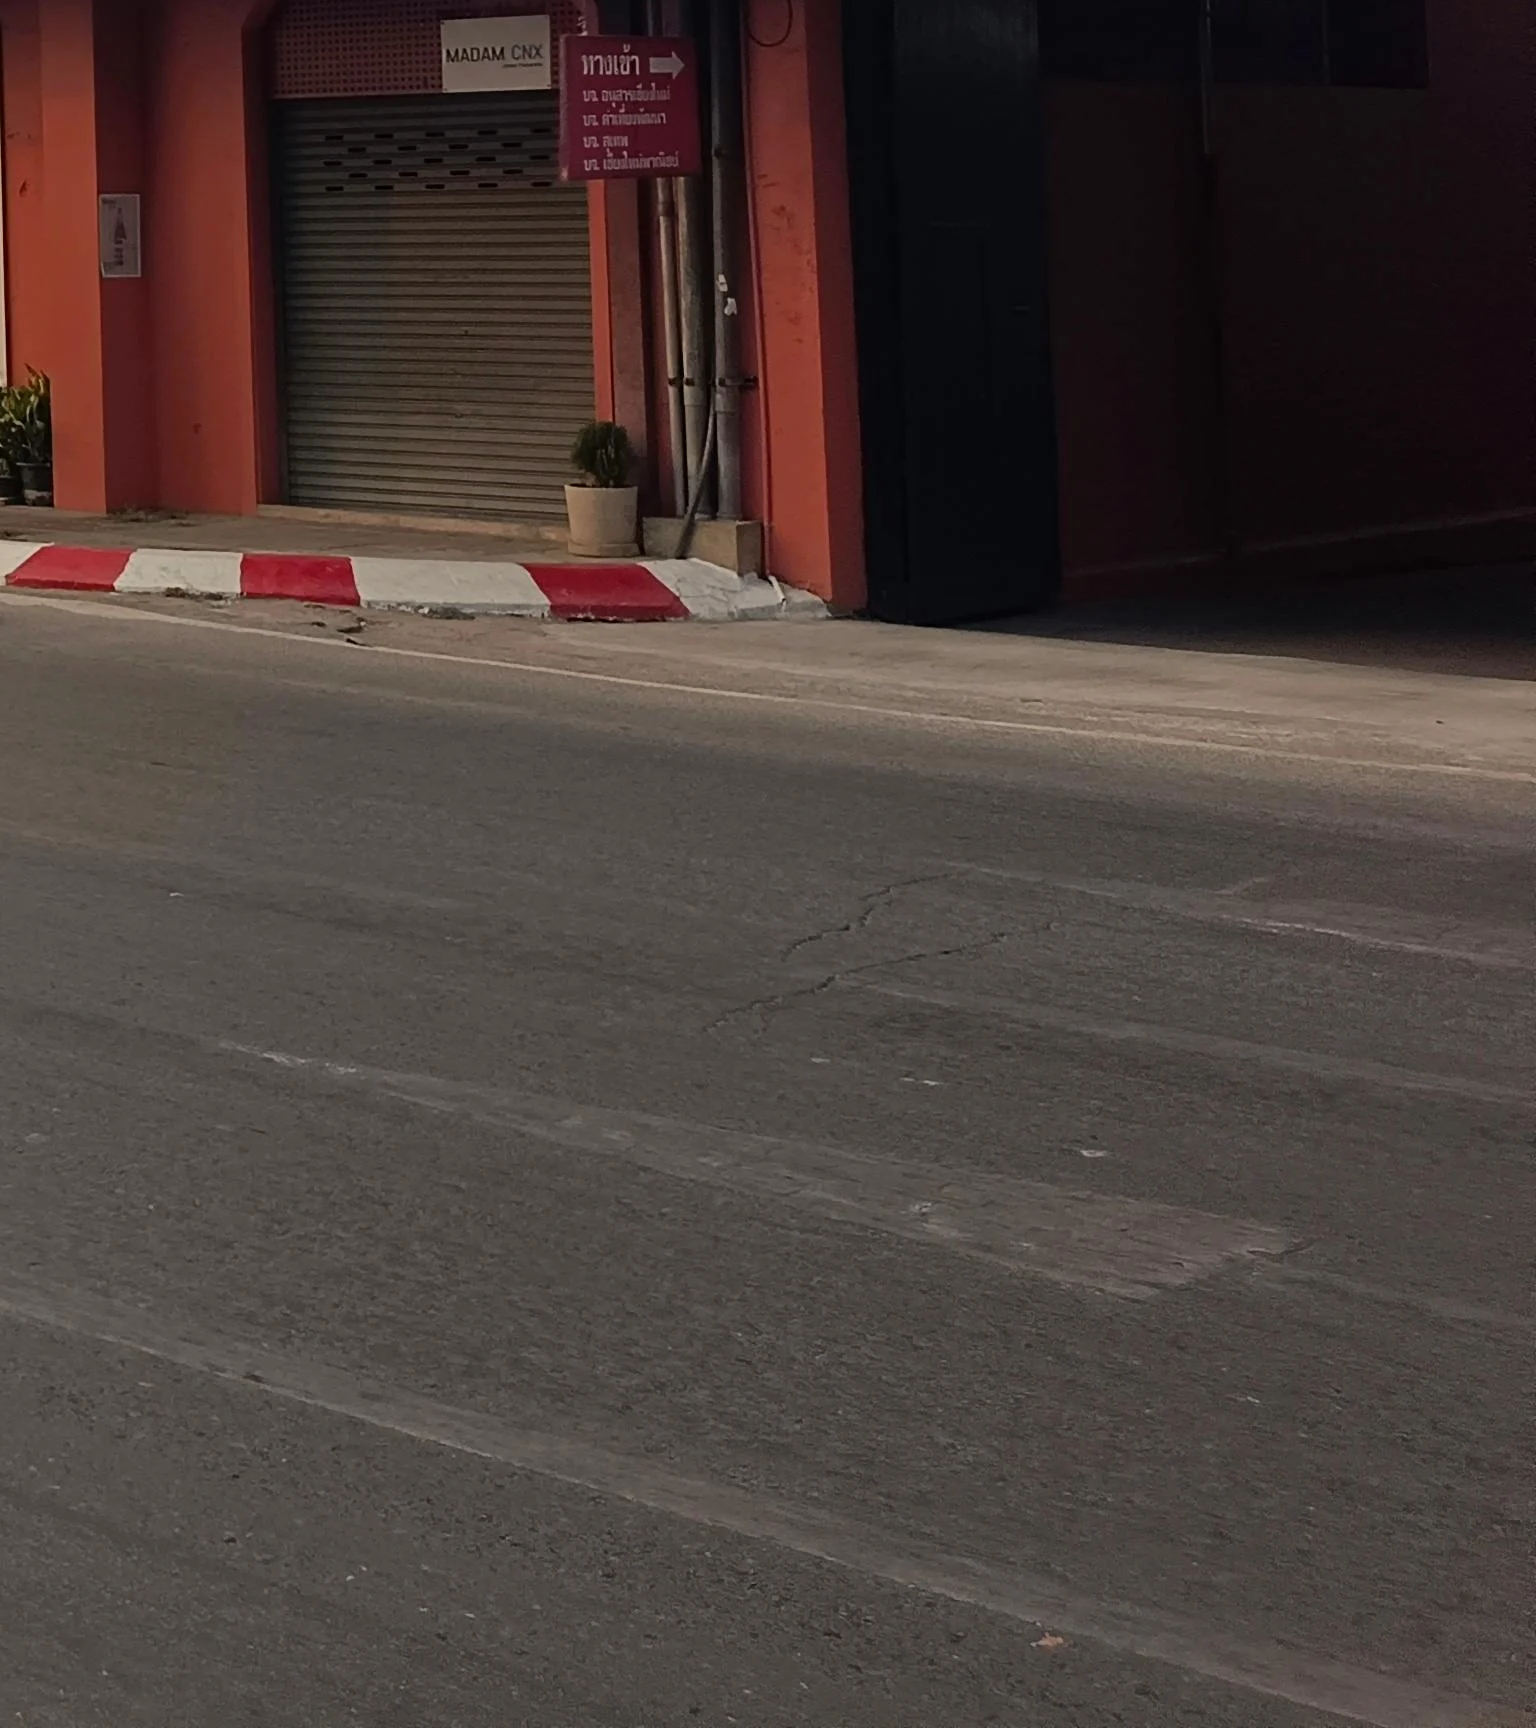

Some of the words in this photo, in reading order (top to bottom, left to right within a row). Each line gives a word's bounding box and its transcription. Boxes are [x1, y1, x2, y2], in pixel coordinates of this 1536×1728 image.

[446, 46, 505, 63] MADAM
[511, 44, 543, 60] CNX
[581, 43, 640, 75] ทางเข้า
